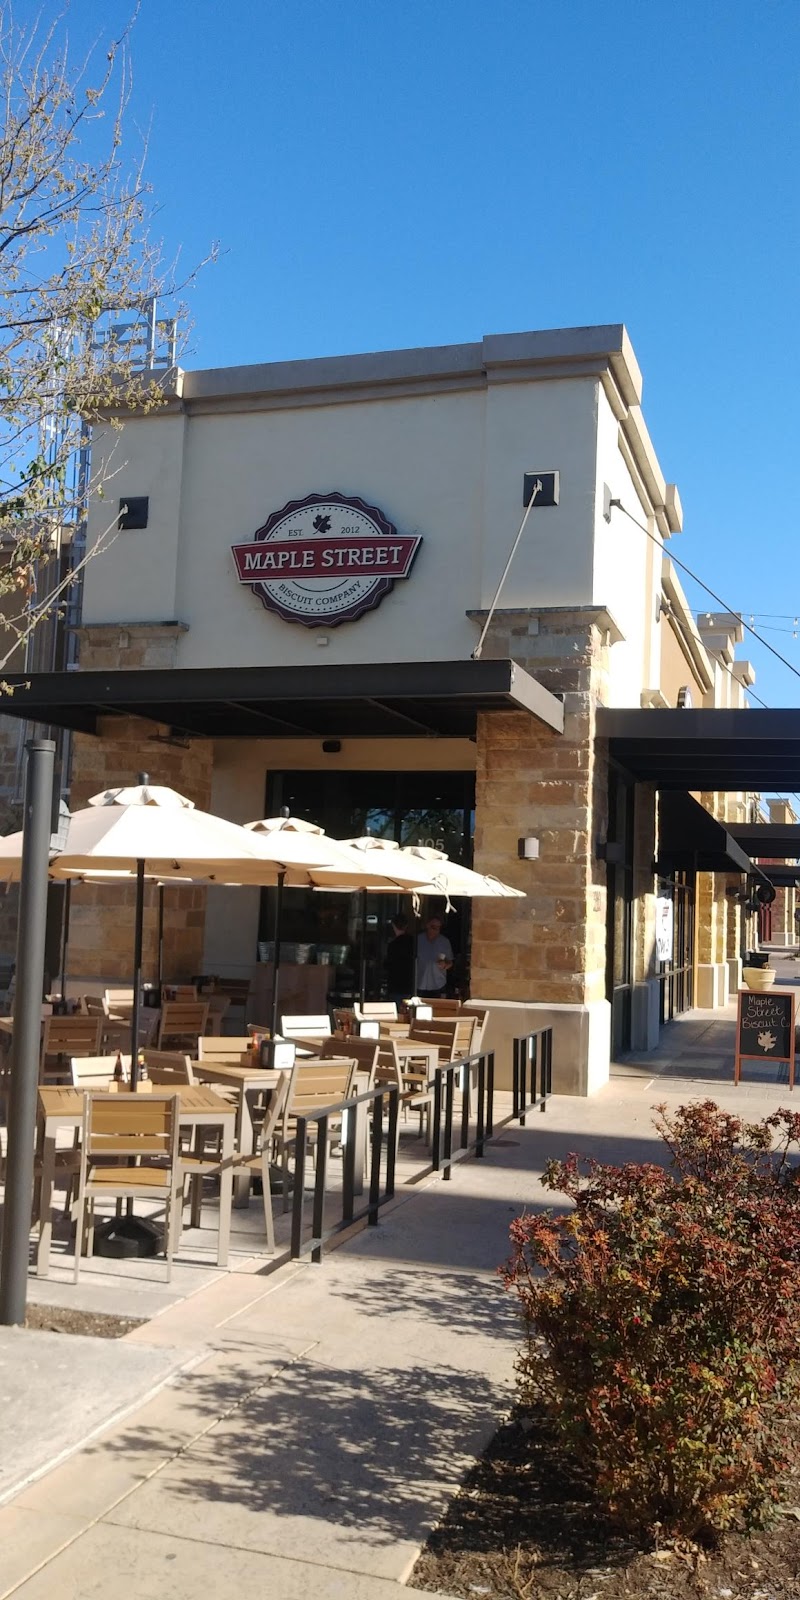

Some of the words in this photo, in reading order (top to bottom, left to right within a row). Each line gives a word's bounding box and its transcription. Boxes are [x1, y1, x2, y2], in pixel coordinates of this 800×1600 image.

[340, 526, 360, 534] 2012
[244, 550, 315, 571] MAPLE
[321, 546, 402, 567] STREET
[278, 583, 314, 605] BISCUIT
[315, 580, 361, 605] COMPANY
[748, 995, 775, 1008] Maple
[746, 1005, 784, 1018] Street
[742, 1017, 779, 1029] Biscuit
